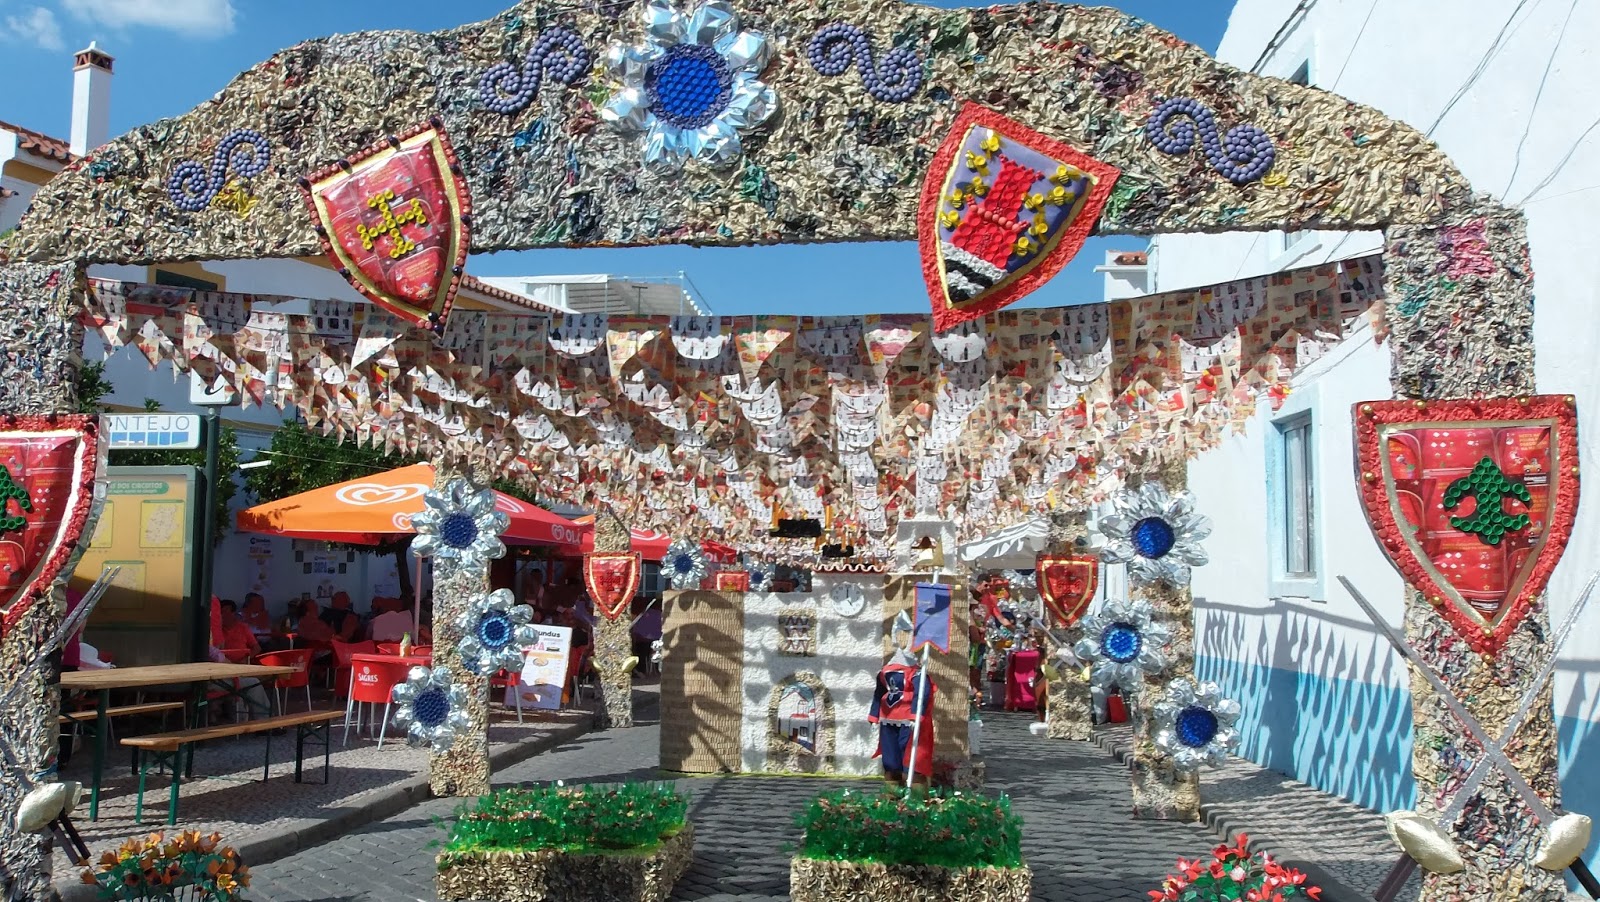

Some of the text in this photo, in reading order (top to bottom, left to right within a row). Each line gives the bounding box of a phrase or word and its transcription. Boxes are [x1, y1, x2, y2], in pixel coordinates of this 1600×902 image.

[111, 415, 190, 431] NTEJO
[537, 630, 561, 638] undus
[358, 672, 379, 683] SAGRES
